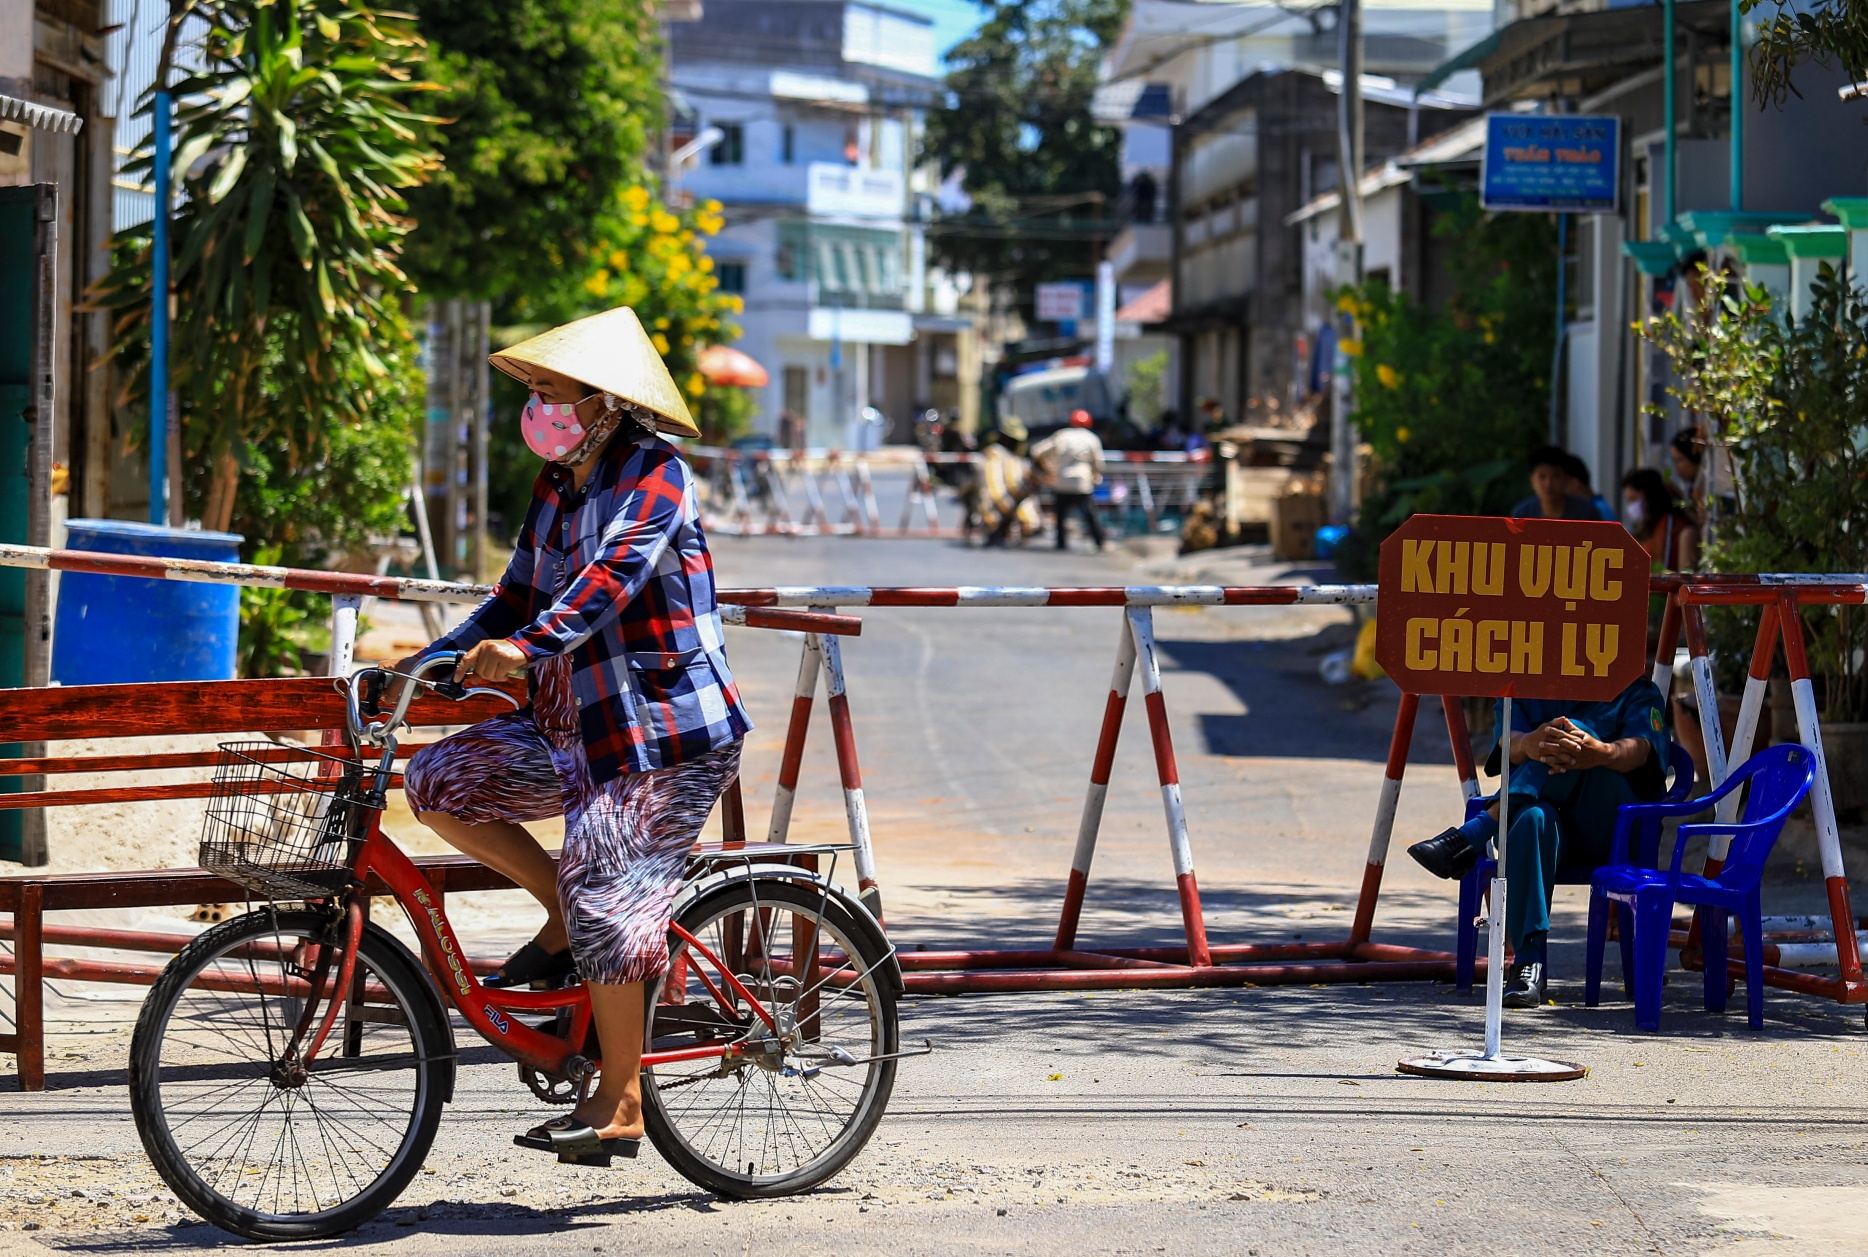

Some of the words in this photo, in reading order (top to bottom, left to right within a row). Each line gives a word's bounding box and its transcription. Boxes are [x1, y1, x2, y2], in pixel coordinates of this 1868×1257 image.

[1401, 539, 1506, 596] KHU
[1519, 541, 1624, 611] VỰC
[1405, 608, 1544, 674] CÁCH
[1561, 623, 1619, 677] LY
[484, 1004, 509, 1034] FILA
